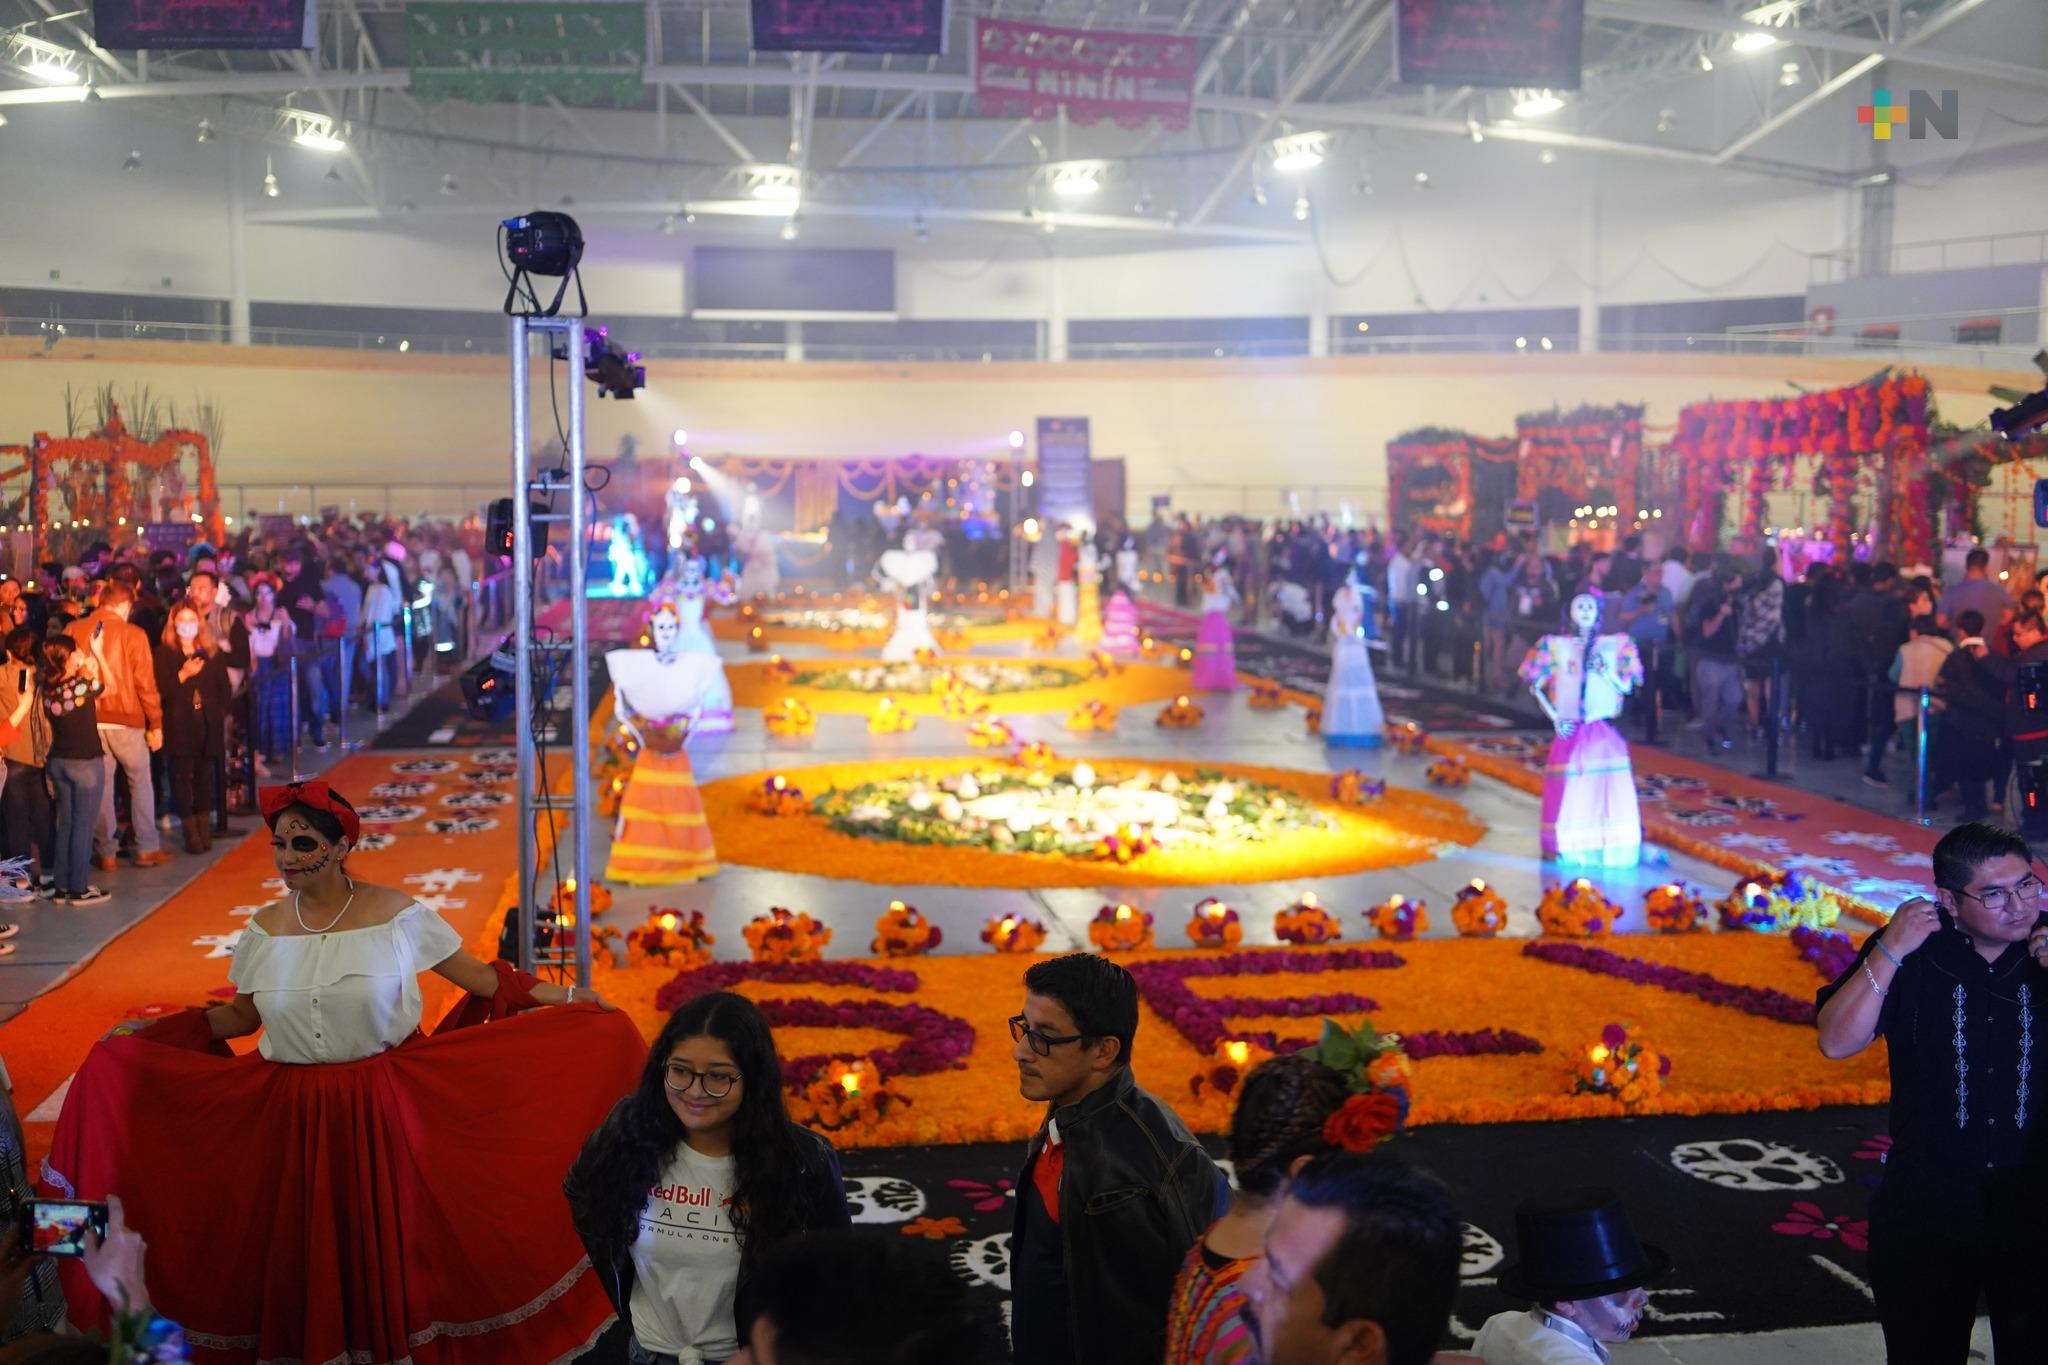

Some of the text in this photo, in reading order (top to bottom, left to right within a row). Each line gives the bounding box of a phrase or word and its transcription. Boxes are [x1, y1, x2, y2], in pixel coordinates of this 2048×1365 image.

[675, 1185, 711, 1207] Bull
[639, 1201, 718, 1226] RACI
[640, 1224, 693, 1239] ORMULA
[702, 1234, 730, 1244] ONE
